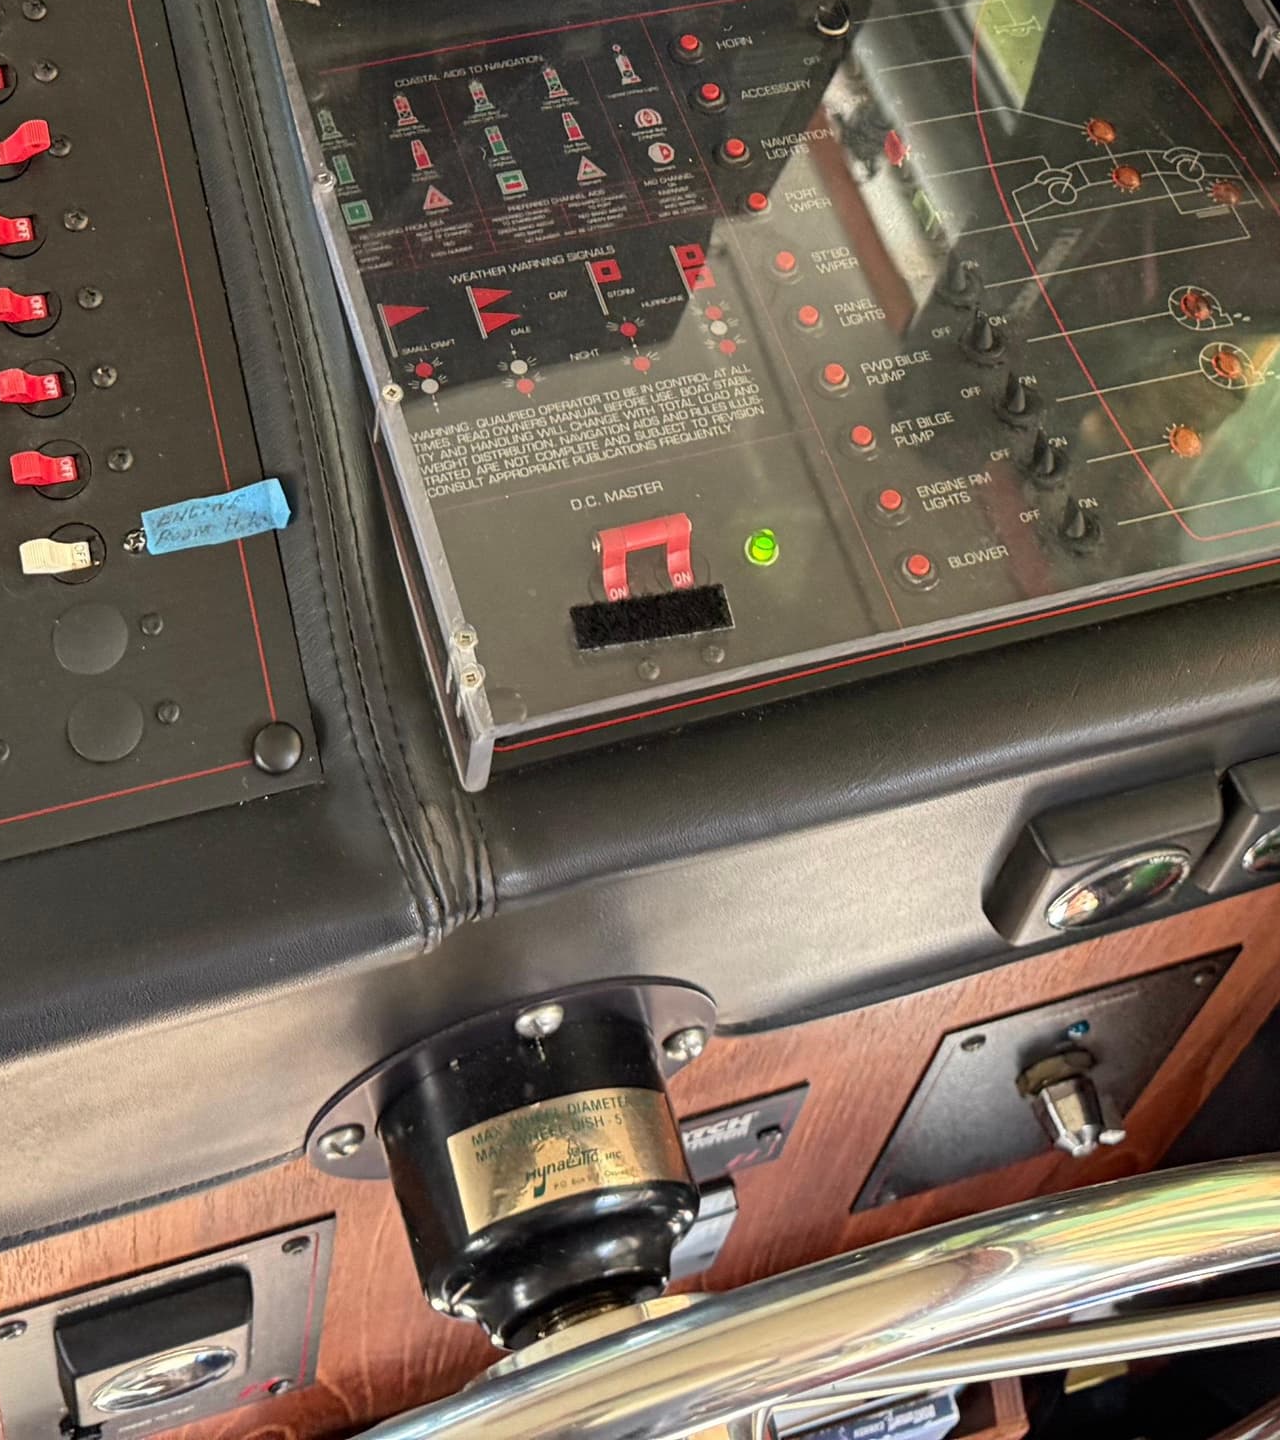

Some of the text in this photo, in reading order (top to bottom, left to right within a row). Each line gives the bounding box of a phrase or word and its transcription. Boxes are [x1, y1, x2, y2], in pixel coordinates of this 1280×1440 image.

[716, 36, 753, 50] HORN
[741, 79, 811, 101] ACCESSORY
[760, 128, 834, 149] NAVIGATION
[766, 144, 810, 160] LIGHTS
[784, 187, 817, 202] PORT
[789, 196, 832, 214] WIPER
[449, 245, 615, 286] WEATHER WARNING SIGNALS
[816, 257, 859, 275] WIPER
[834, 298, 877, 315] PANEL
[839, 308, 886, 327] LIGHTS
[860, 350, 932, 374] FWD BILGE
[866, 369, 906, 386] PUMP
[890, 412, 955, 435] AFT BILGE
[894, 430, 935, 448] PUMP
[916, 472, 993, 498] ENGINE RM
[571, 480, 664, 511] D.C. MASTER
[923, 492, 971, 512] LIGHTS
[947, 545, 1009, 569] BLOWER
